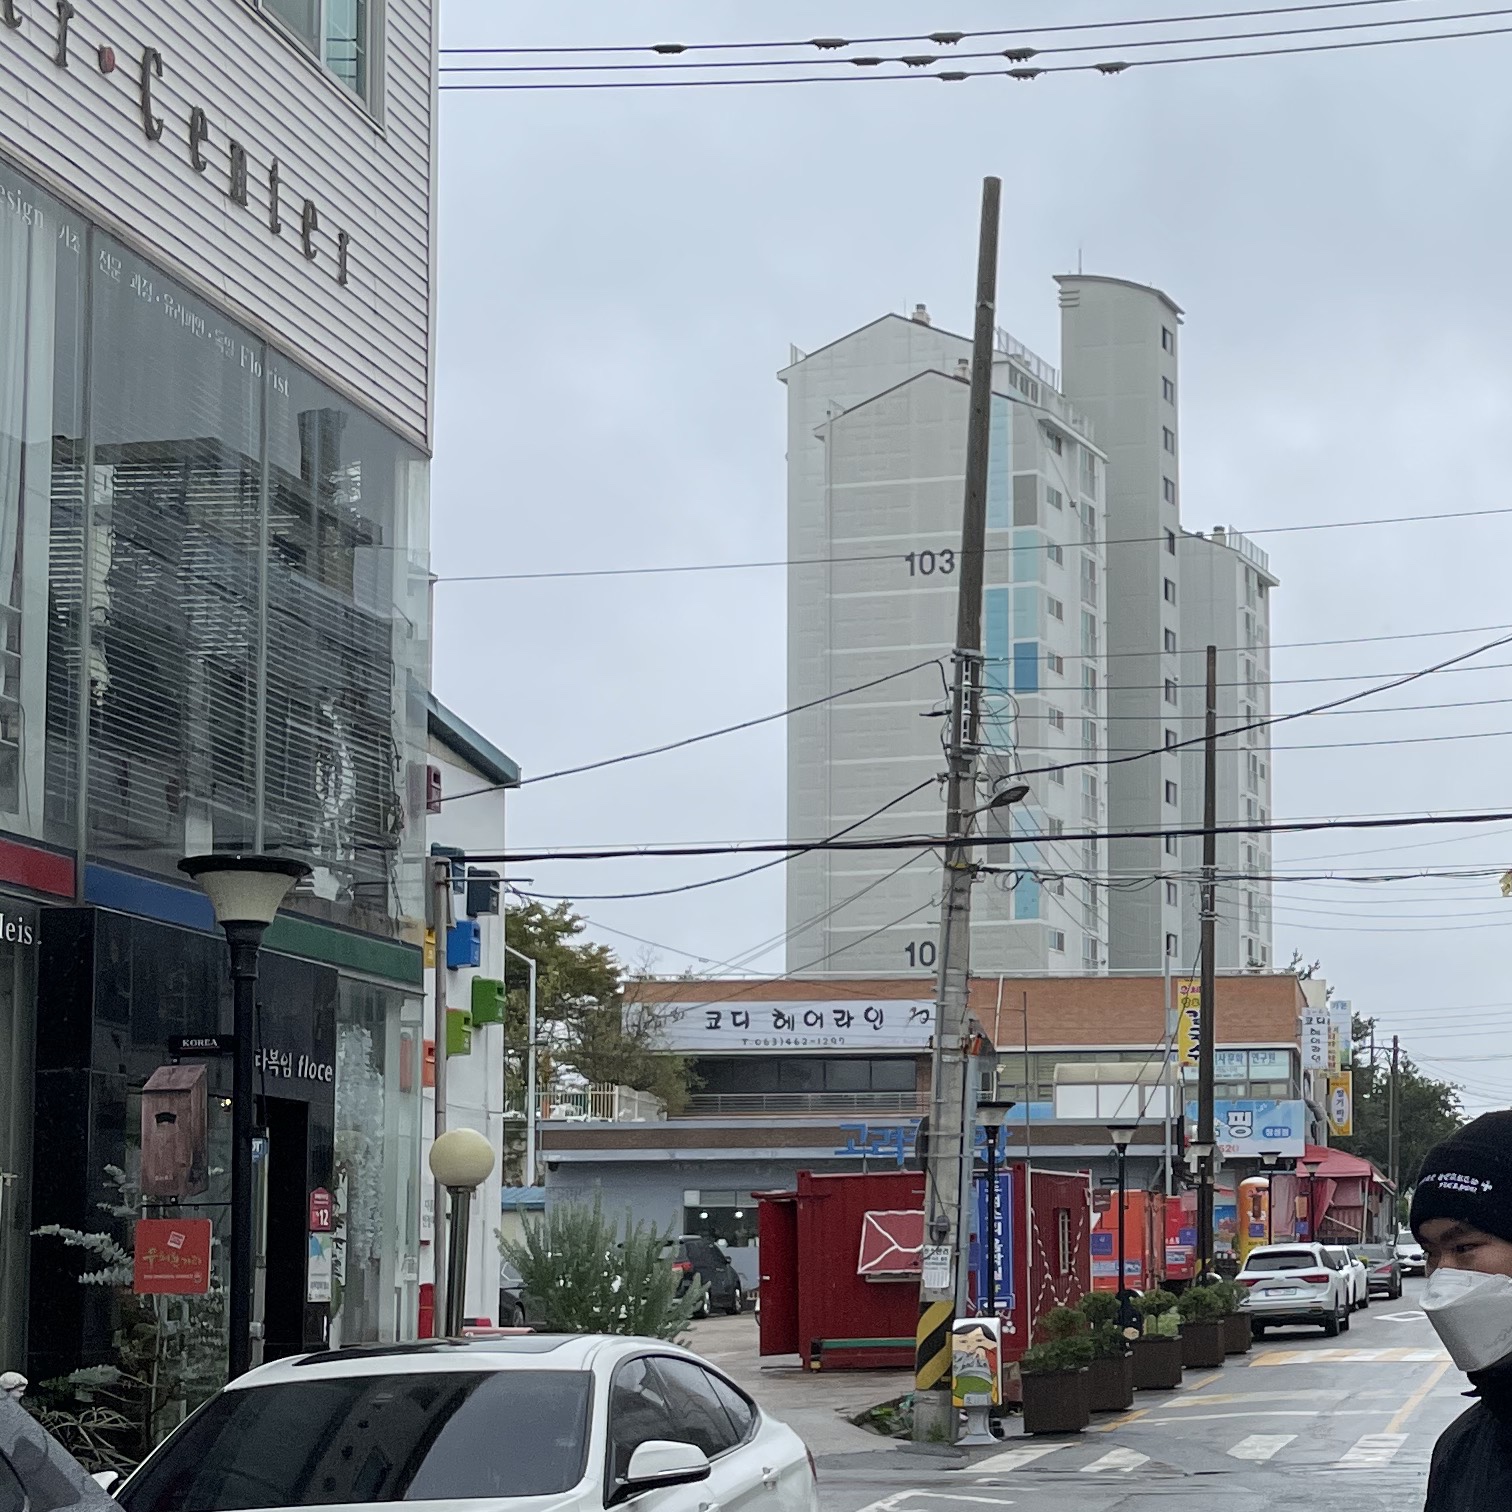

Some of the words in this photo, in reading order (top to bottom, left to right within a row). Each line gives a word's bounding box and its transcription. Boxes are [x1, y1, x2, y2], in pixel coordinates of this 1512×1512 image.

[905, 549, 956, 577] 103
[905, 940, 937, 967] 10
[705, 1009, 750, 1031] 코디
[771, 1005, 885, 1032] 헤어라인
[181, 1038, 218, 1048] KOREA
